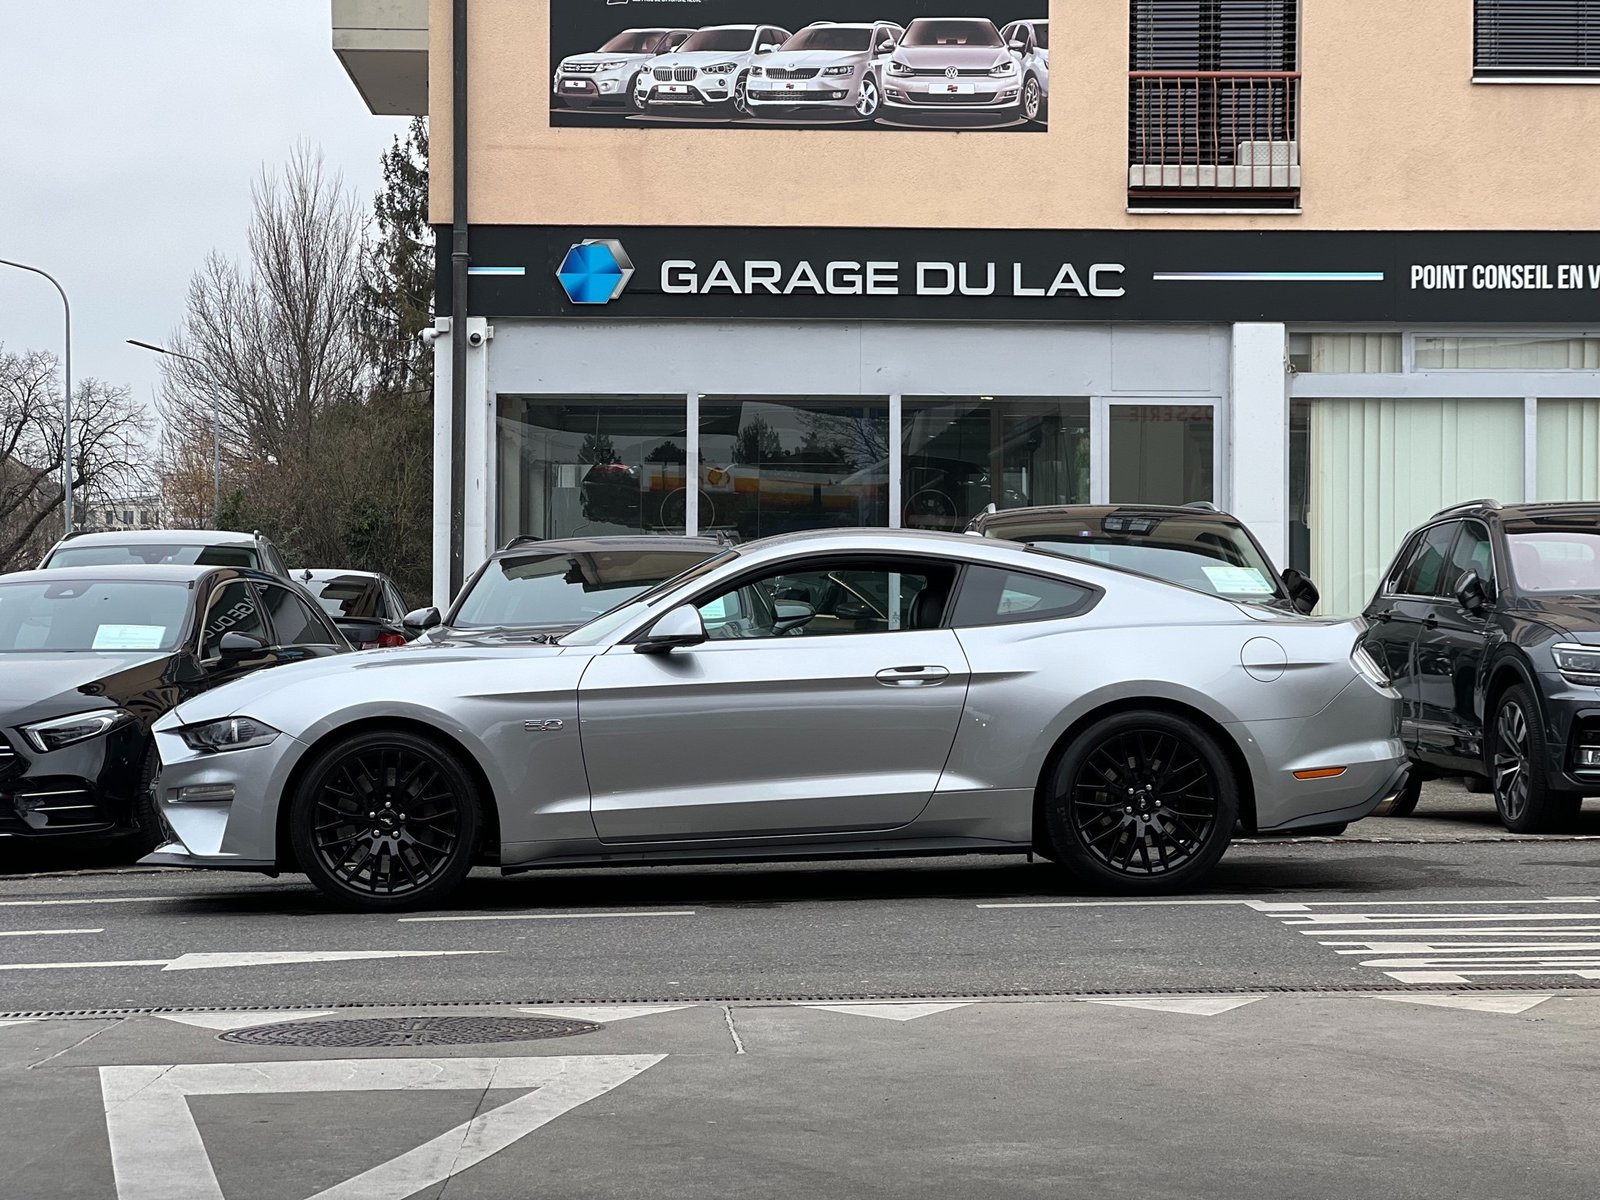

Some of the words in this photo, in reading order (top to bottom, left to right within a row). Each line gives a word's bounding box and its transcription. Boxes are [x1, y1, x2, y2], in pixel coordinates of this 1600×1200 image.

[661, 259, 899, 295] GARAGE
[916, 261, 995, 296] DU
[1013, 262, 1126, 297] LAC
[1411, 264, 1468, 290] POINT
[1472, 264, 1553, 290] CONSEIL
[1557, 264, 1584, 289] EN
